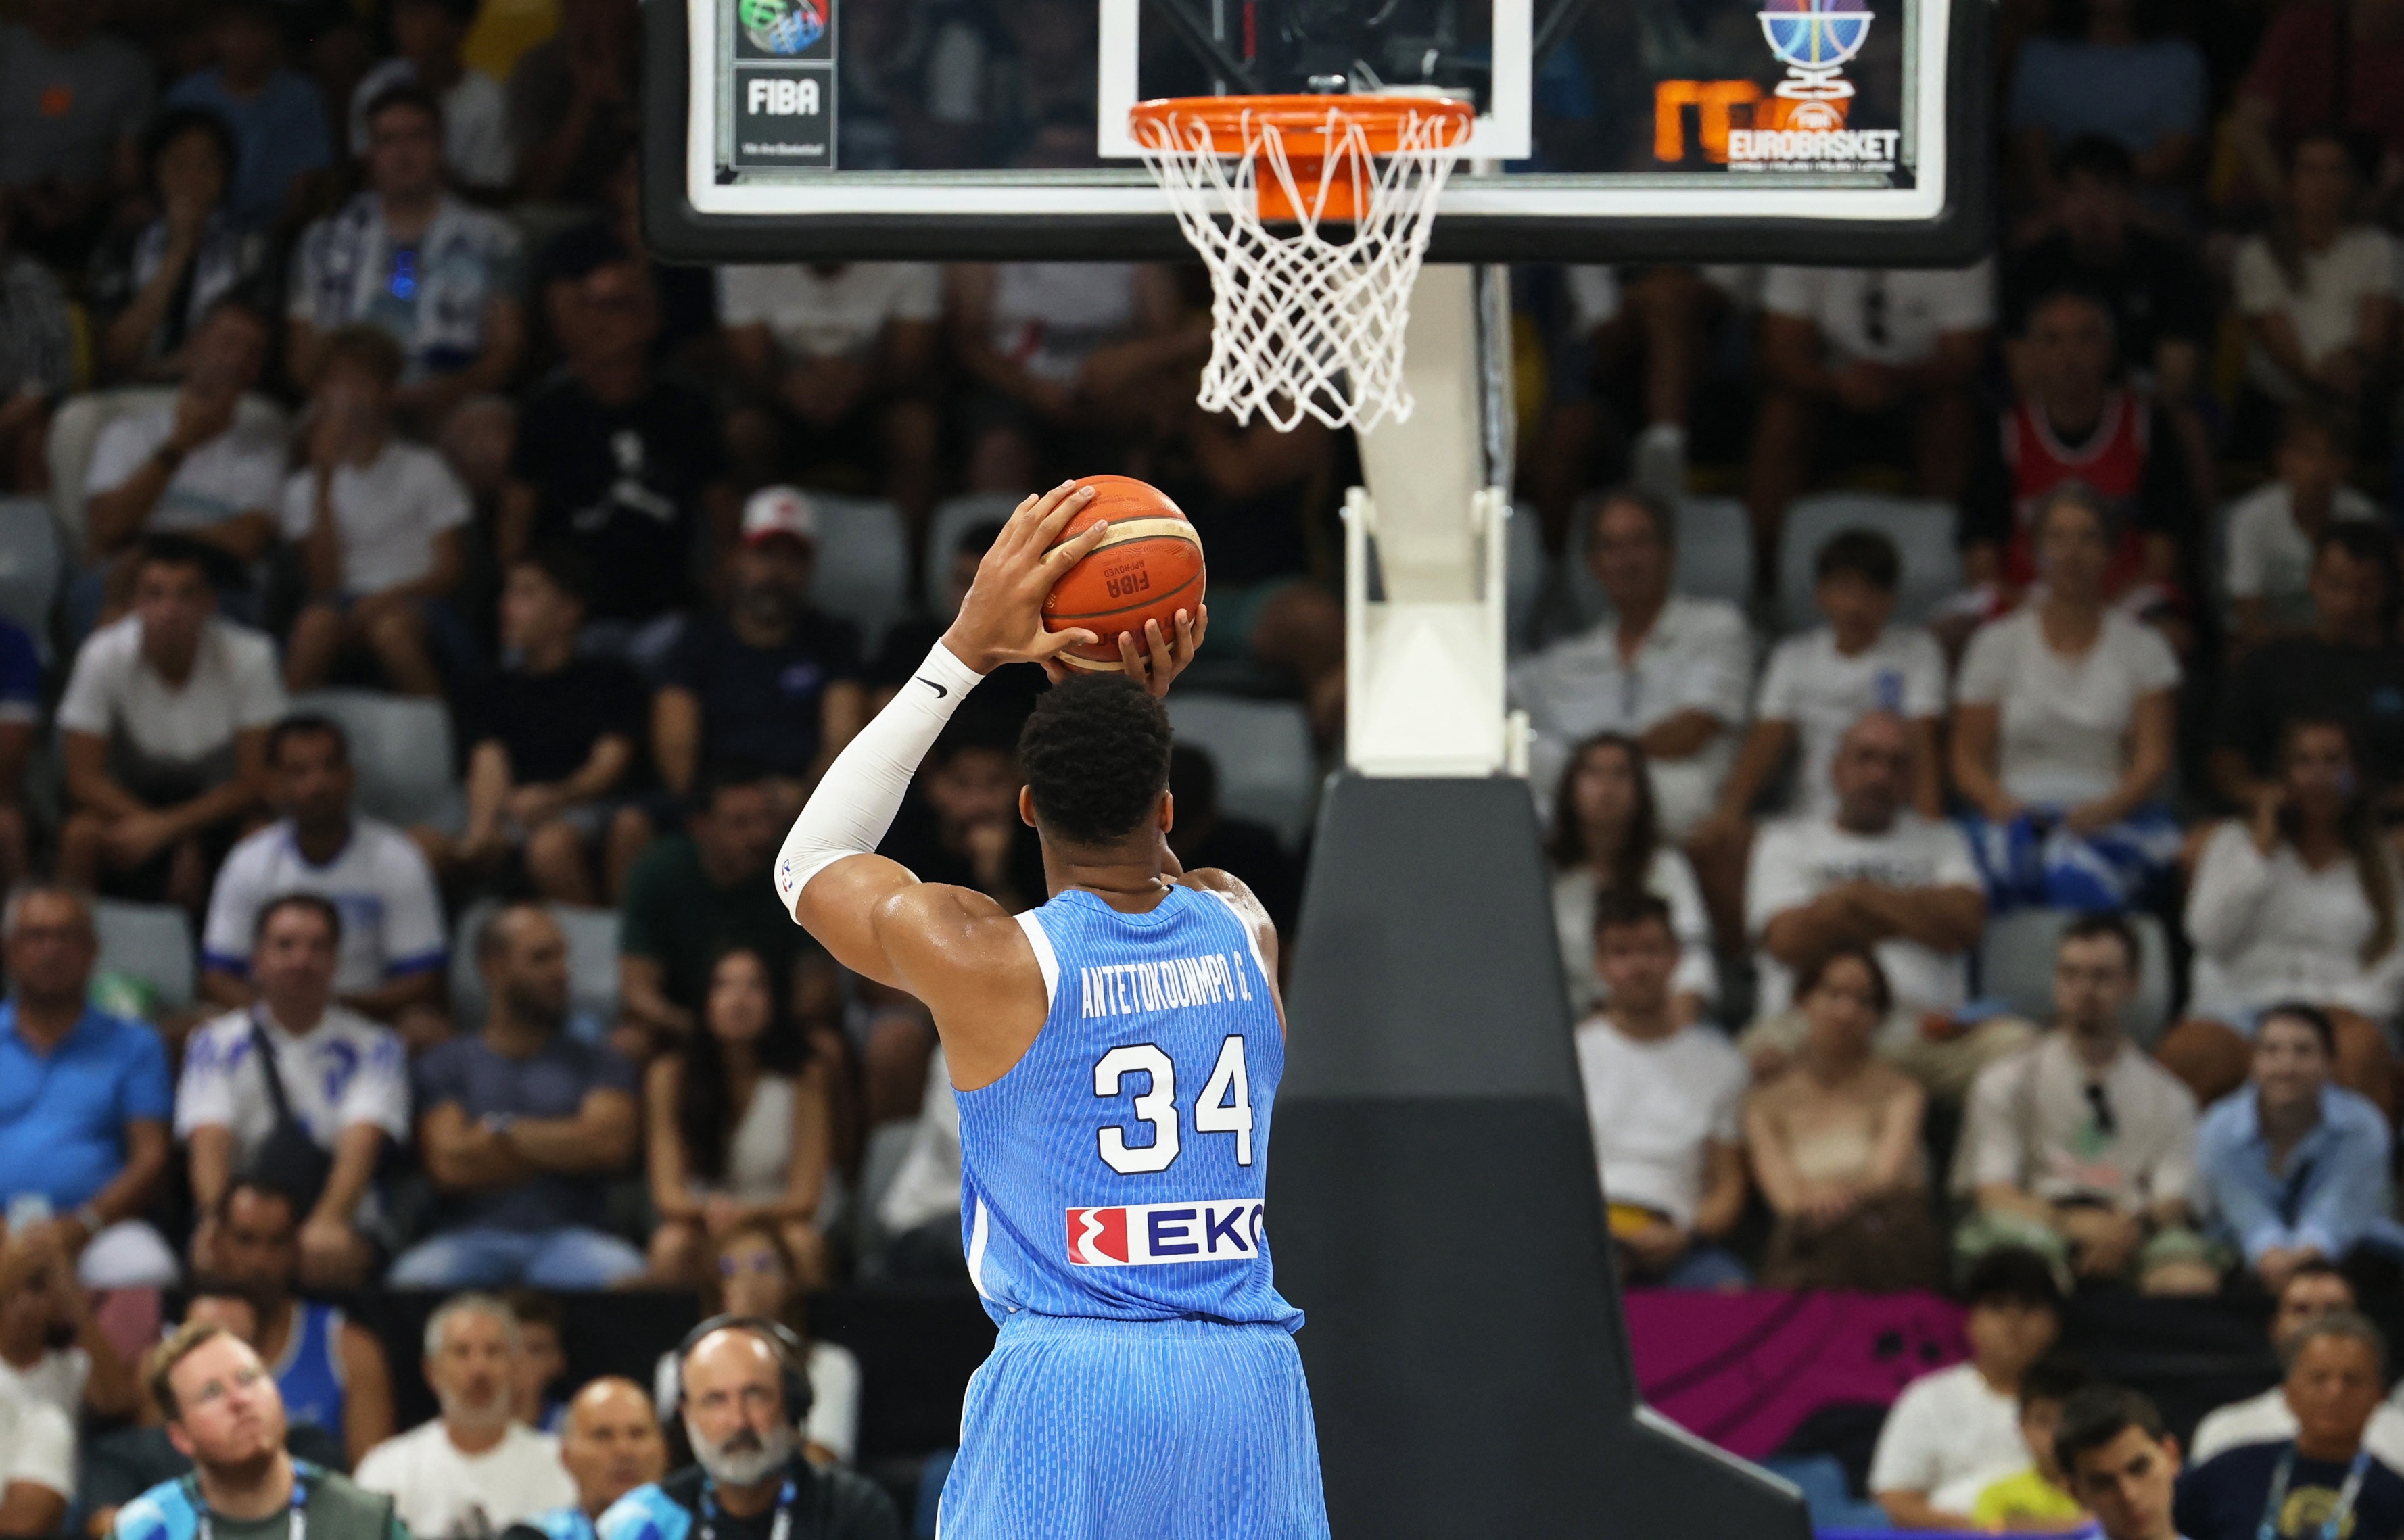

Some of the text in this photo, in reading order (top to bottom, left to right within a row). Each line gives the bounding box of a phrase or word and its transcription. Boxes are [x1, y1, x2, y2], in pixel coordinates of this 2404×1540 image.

[748, 78, 820, 115] FIBA
[1729, 129, 1900, 160] EUROBASKET
[1104, 560, 1144, 577] APPROVED
[1106, 570, 1150, 598] FIBA
[1081, 951, 1252, 1019] ANTETOKOUNMPO G.
[1093, 1034, 1253, 1176] 34
